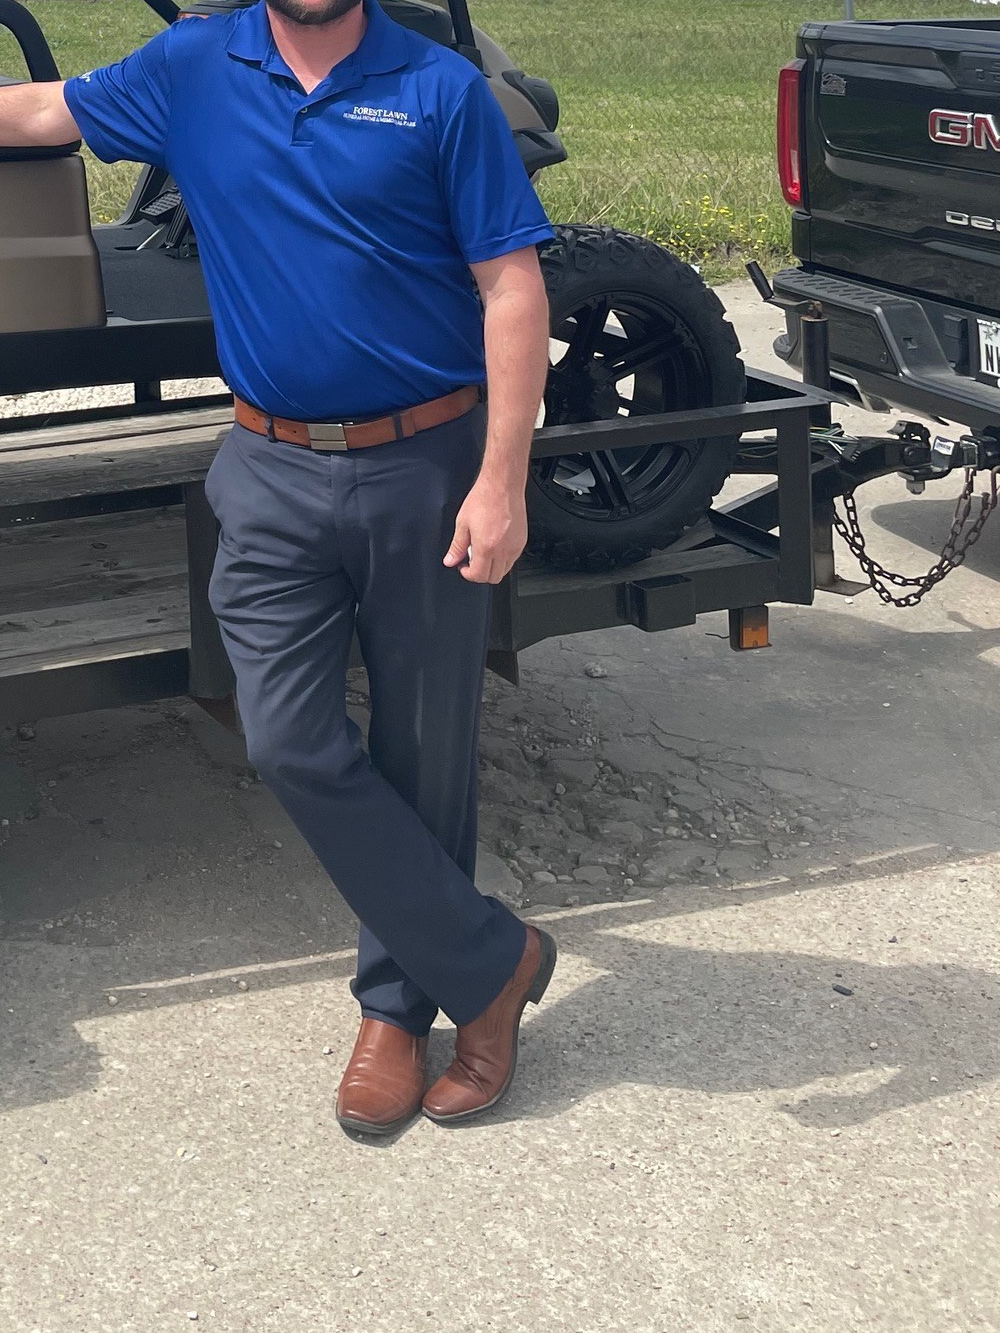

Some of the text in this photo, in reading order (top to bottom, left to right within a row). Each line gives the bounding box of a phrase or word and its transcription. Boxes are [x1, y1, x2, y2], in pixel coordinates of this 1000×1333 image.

[353, 106, 408, 121] FOREST LAWN
[945, 210, 1000, 232] DE
[984, 343, 1000, 375] N
